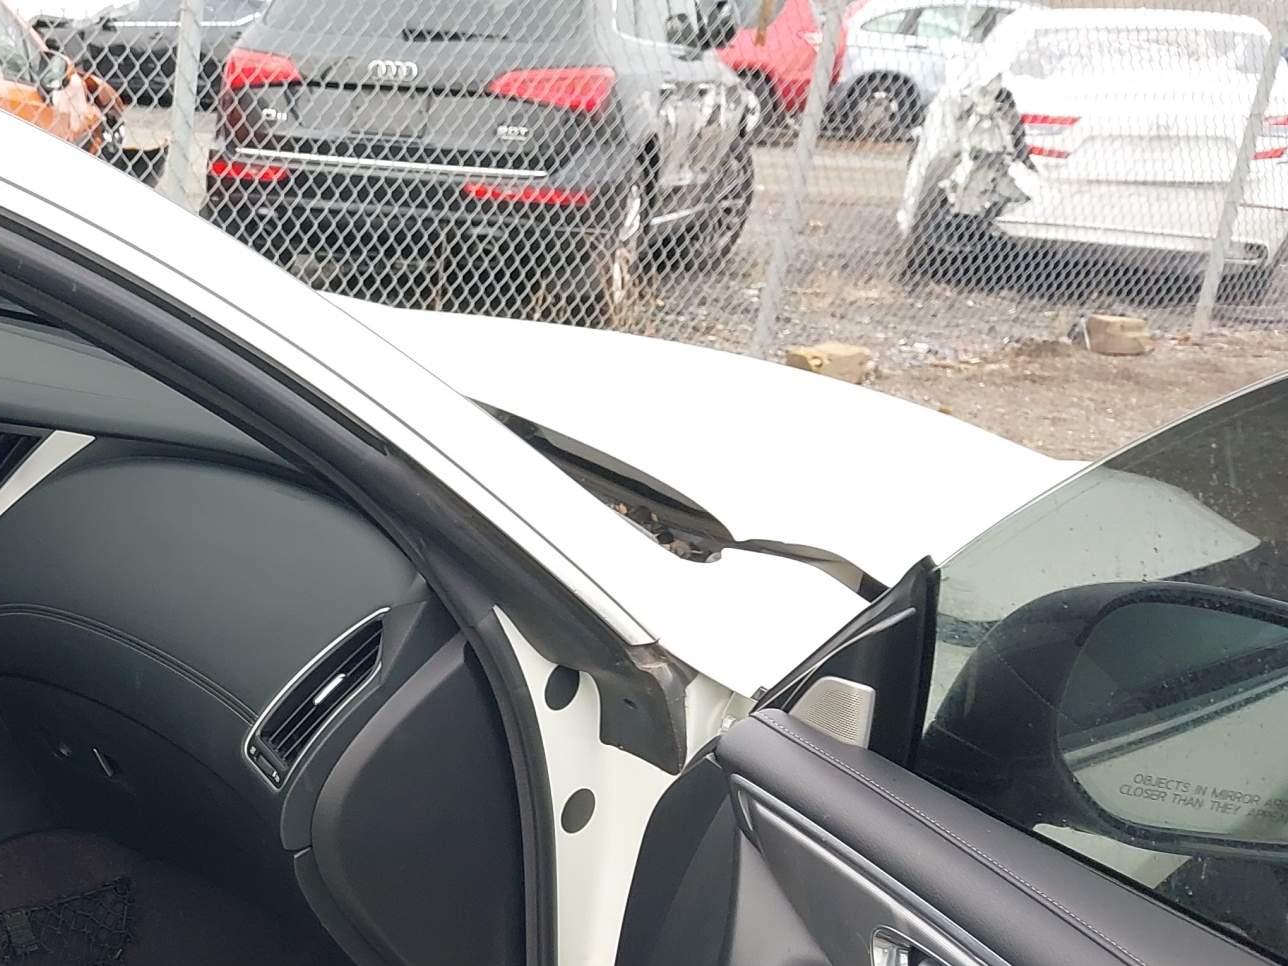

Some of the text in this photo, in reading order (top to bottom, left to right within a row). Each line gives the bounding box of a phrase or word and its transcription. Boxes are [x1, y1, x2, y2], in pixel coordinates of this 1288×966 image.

[1119, 784, 1167, 802] CLOSER
[1172, 793, 1205, 809] THAN
[1210, 800, 1241, 815] THEY
[1133, 773, 1191, 793] OBJECTS
[1194, 784, 1208, 796] IN
[1210, 787, 1261, 806] MIRROR
